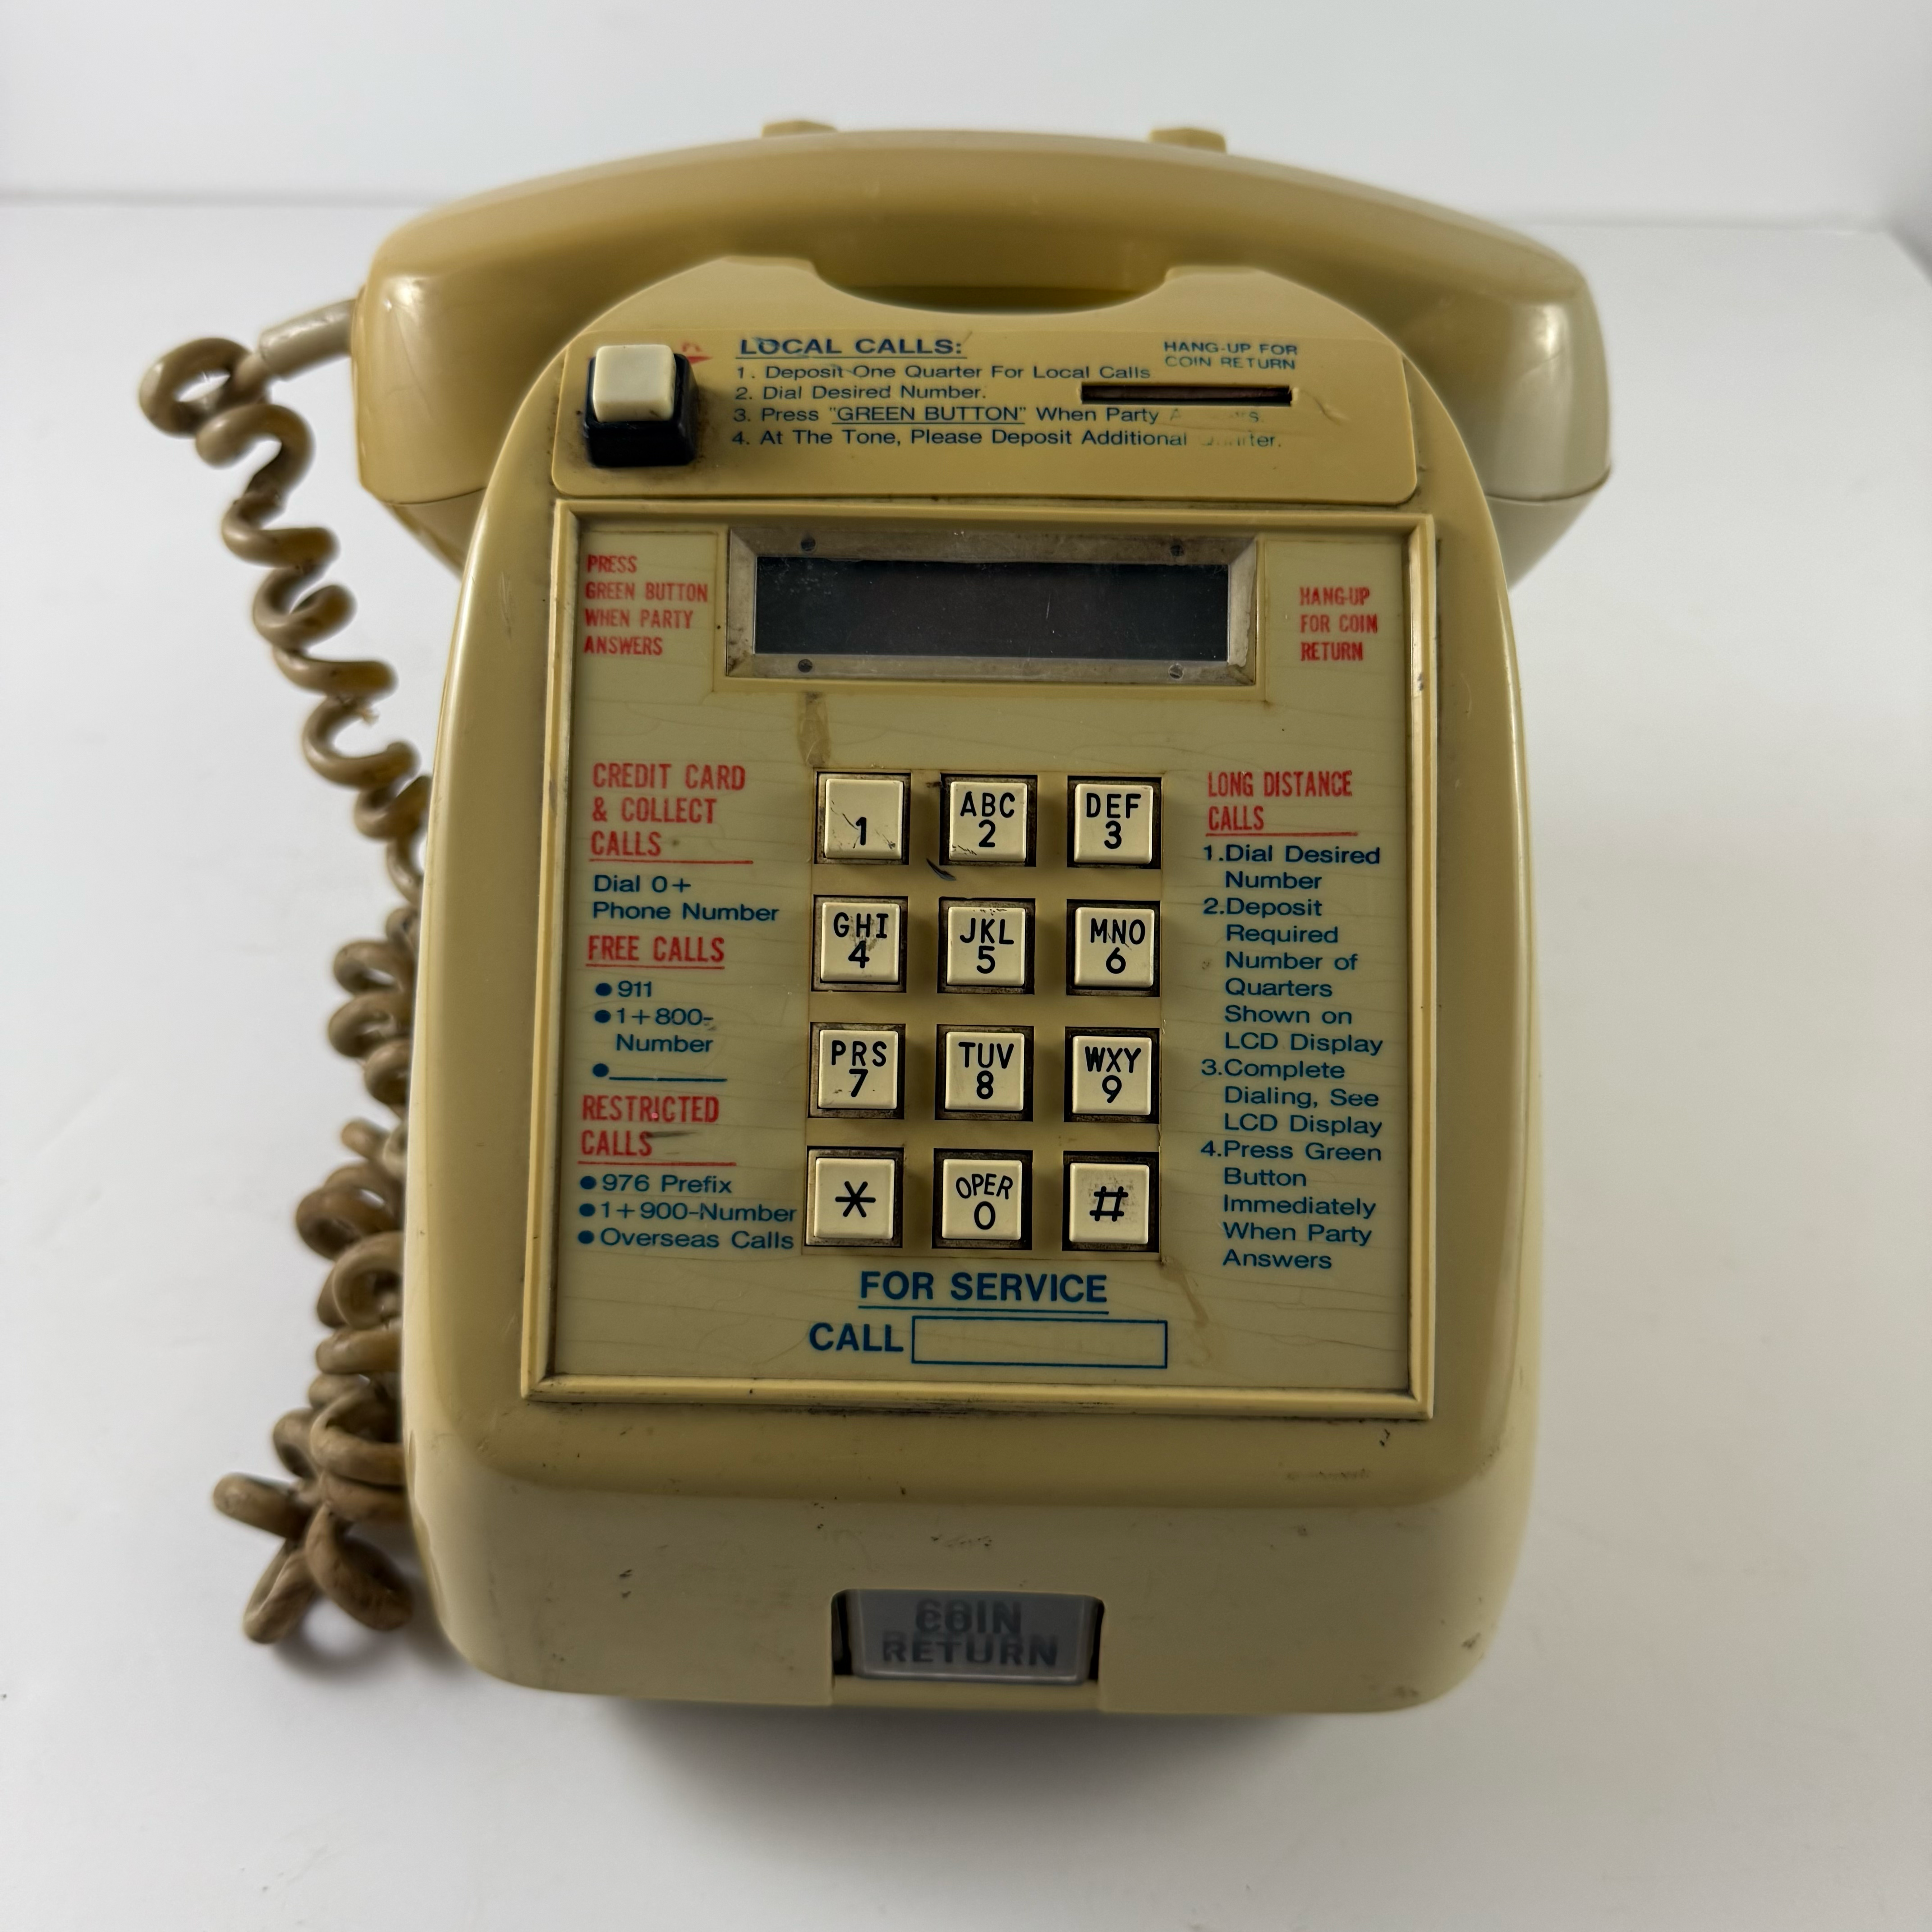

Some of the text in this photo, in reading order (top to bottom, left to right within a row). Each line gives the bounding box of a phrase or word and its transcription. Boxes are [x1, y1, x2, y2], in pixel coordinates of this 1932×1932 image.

[740, 339, 962, 355] LOCAL CALLS:
[1164, 341, 1297, 355] HANG-UP FOR
[737, 365, 1150, 382] 1. Deposit One Quarter For Local Calls
[1165, 356, 1295, 370] COIN RETURN
[736, 386, 986, 400] 2. Dial Desired Number.
[734, 409, 751, 422] 3.
[762, 409, 819, 422] Press
[1037, 407, 1096, 421] When
[1107, 407, 1159, 425] Party
[732, 432, 749, 445] 4.
[760, 431, 782, 445] At
[793, 431, 832, 445] The
[845, 431, 901, 446] Tone,
[911, 430, 982, 445] Please
[992, 430, 1072, 447] Deposit
[1082, 430, 1187, 446] Additional
[587, 554, 638, 573] PRESS
[584, 582, 708, 602] GREEN BUTTON
[1300, 587, 1370, 606] HANG-UP
[584, 608, 694, 629] WHEN PARTY
[1301, 614, 1378, 633] FOR COIN
[584, 635, 662, 655] ANSWERS
[1301, 641, 1363, 661] RETURN
[592, 763, 745, 791] CREDIT CARD
[1208, 770, 1352, 797] LONG DISTANCE
[593, 796, 717, 823] & COLLECT
[960, 791, 1015, 818] ABC
[1086, 793, 1141, 819] DEF
[1209, 805, 1264, 830] CALLS
[591, 830, 661, 856] CALLS
[856, 817, 866, 845] 1
[978, 819, 996, 847] 2
[1104, 820, 1122, 849] 3
[1285, 845, 1380, 864] Desired
[594, 875, 640, 892] Dial
[1226, 871, 1322, 889] Number
[593, 901, 779, 921] Phone Number
[834, 912, 888, 938] GHI
[960, 917, 1014, 944] JKL
[1091, 919, 1145, 944] MNO
[1227, 924, 1338, 945] Required
[588, 935, 725, 963] FREE CALLS
[848, 941, 870, 968] 4
[976, 946, 995, 974] 5
[1106, 947, 1126, 974] 6
[1226, 952, 1358, 970] Number of
[617, 980, 652, 998] 911
[1225, 978, 1332, 997] Quarters
[617, 1008, 713, 1026] 1+800-
[1225, 1005, 1352, 1024] Shown on
[616, 1034, 713, 1053] Number
[831, 1040, 887, 1067] PRS
[959, 1042, 1014, 1069] TUV
[1225, 1032, 1383, 1056] LCD Display
[1085, 1046, 1141, 1073] WXY
[849, 1069, 868, 1097] 7
[976, 1071, 994, 1099] 8
[1102, 1075, 1122, 1103] 9
[582, 1095, 719, 1122] RESTRICTED
[1225, 1086, 1379, 1109] Dialing, See
[1225, 1113, 1382, 1137] LCD Display
[581, 1130, 653, 1157] CALLS
[1305, 1142, 1381, 1161] Green
[602, 1173, 732, 1193] 976 Prefix
[956, 1173, 1013, 1200] OPER
[1224, 1167, 1306, 1186] Button
[601, 1201, 797, 1222] 1+900-Number
[974, 1201, 995, 1230] 0
[1089, 1186, 1128, 1221] #
[1224, 1194, 1376, 1219] Immediately
[600, 1228, 794, 1250] Overseas Calls
[1223, 1222, 1371, 1246] When Party
[1223, 1249, 1332, 1269] Answers
[860, 1271, 1107, 1303] FOR SERVICE
[809, 1323, 903, 1352] CALL
[915, 1598, 1021, 1633] COIN
[883, 1633, 1058, 1665] RETURN
